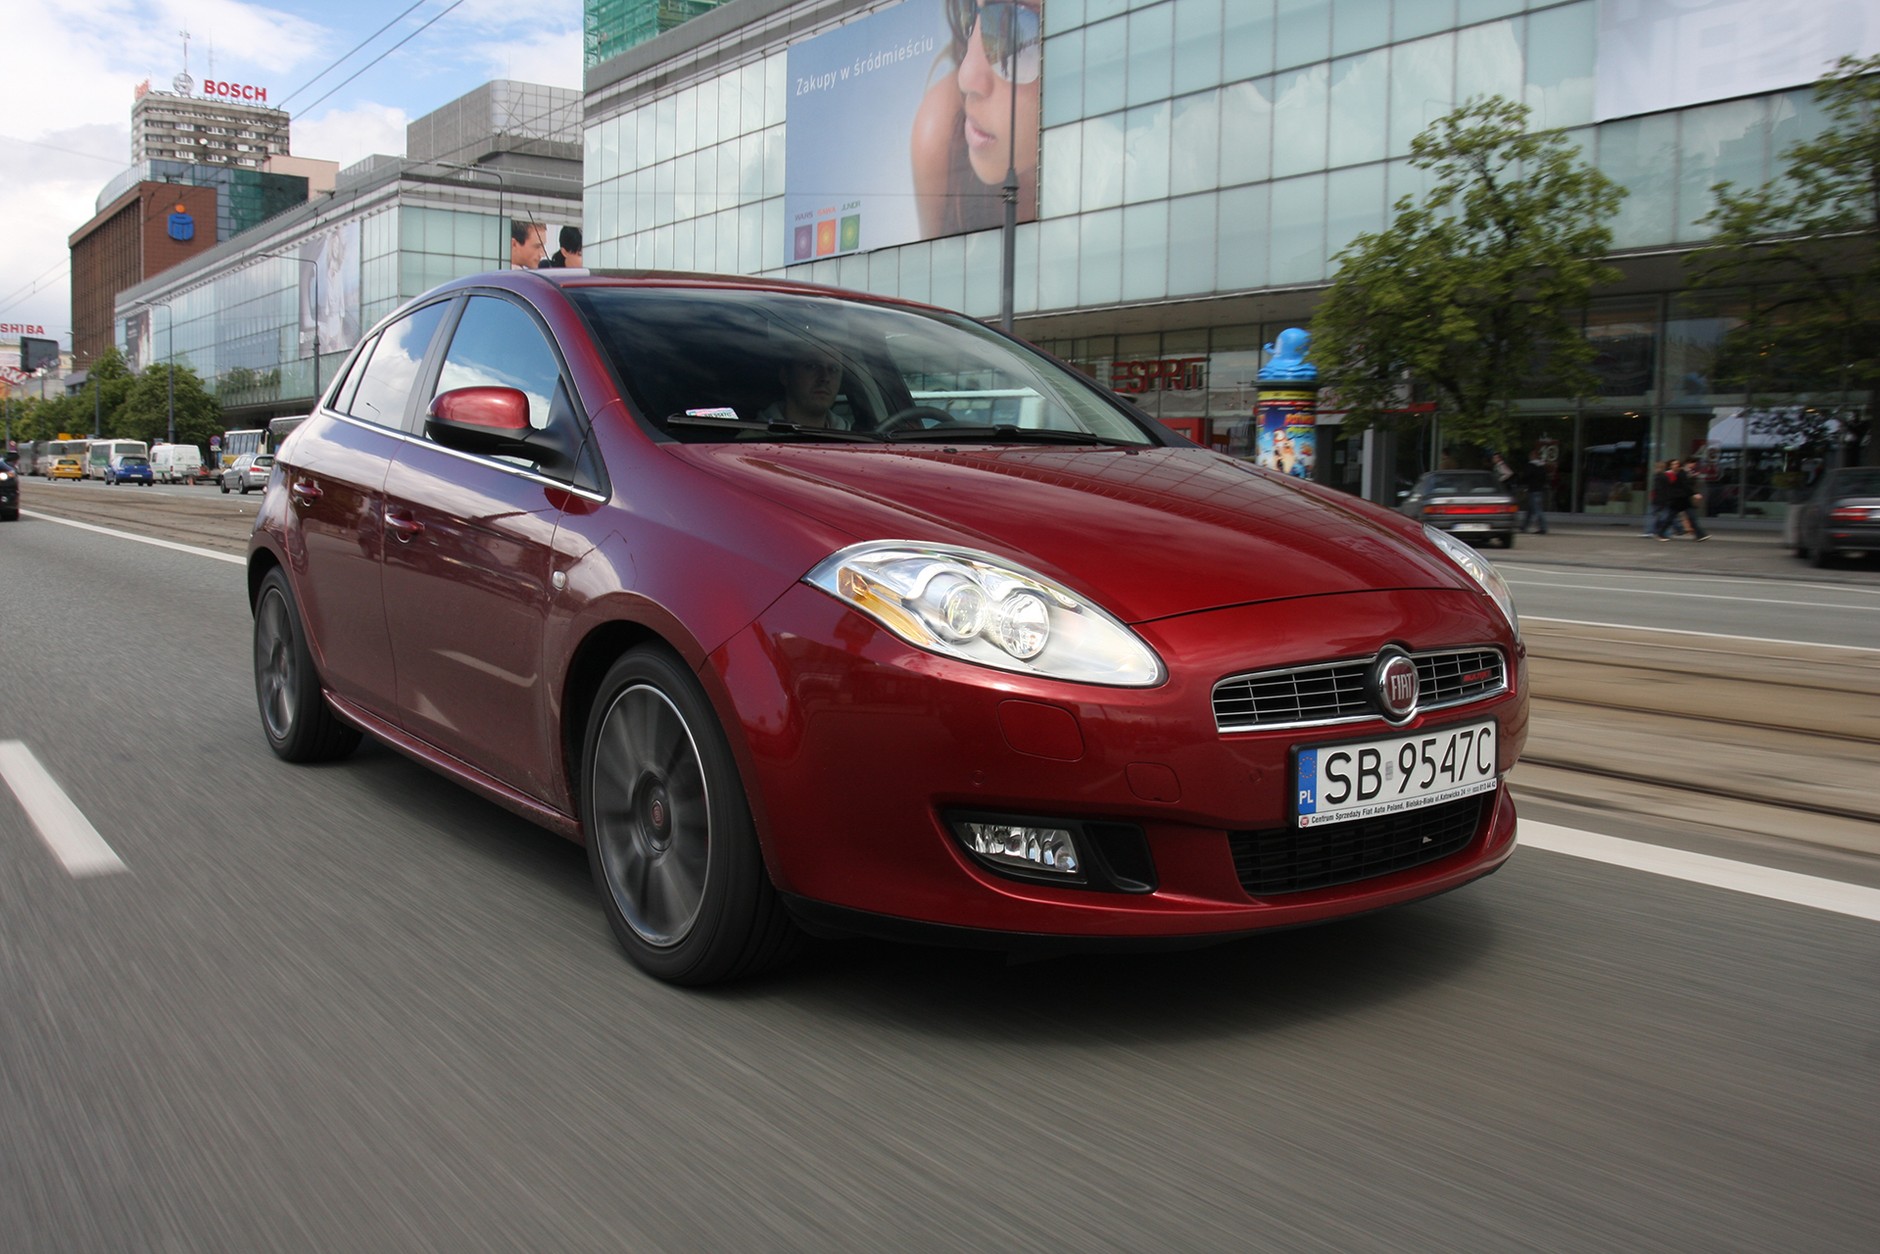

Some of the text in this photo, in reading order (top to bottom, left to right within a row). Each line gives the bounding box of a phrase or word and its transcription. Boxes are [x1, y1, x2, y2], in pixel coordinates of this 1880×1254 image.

[796, 35, 934, 96] Zakupy w śródmieściu
[203, 79, 267, 101] BOSCH
[1111, 356, 1209, 394] ESPRIT
[1390, 672, 1413, 701] FIAT
[1325, 726, 1492, 805] SB 9547C
[1299, 789, 1314, 805] PL
[1311, 814, 1335, 824] Centrum
[1335, 809, 1361, 821] Sprzedaży
[1362, 807, 1373, 816] Fiat
[1374, 805, 1386, 814] Auto
[1386, 802, 1405, 812] Poland,
